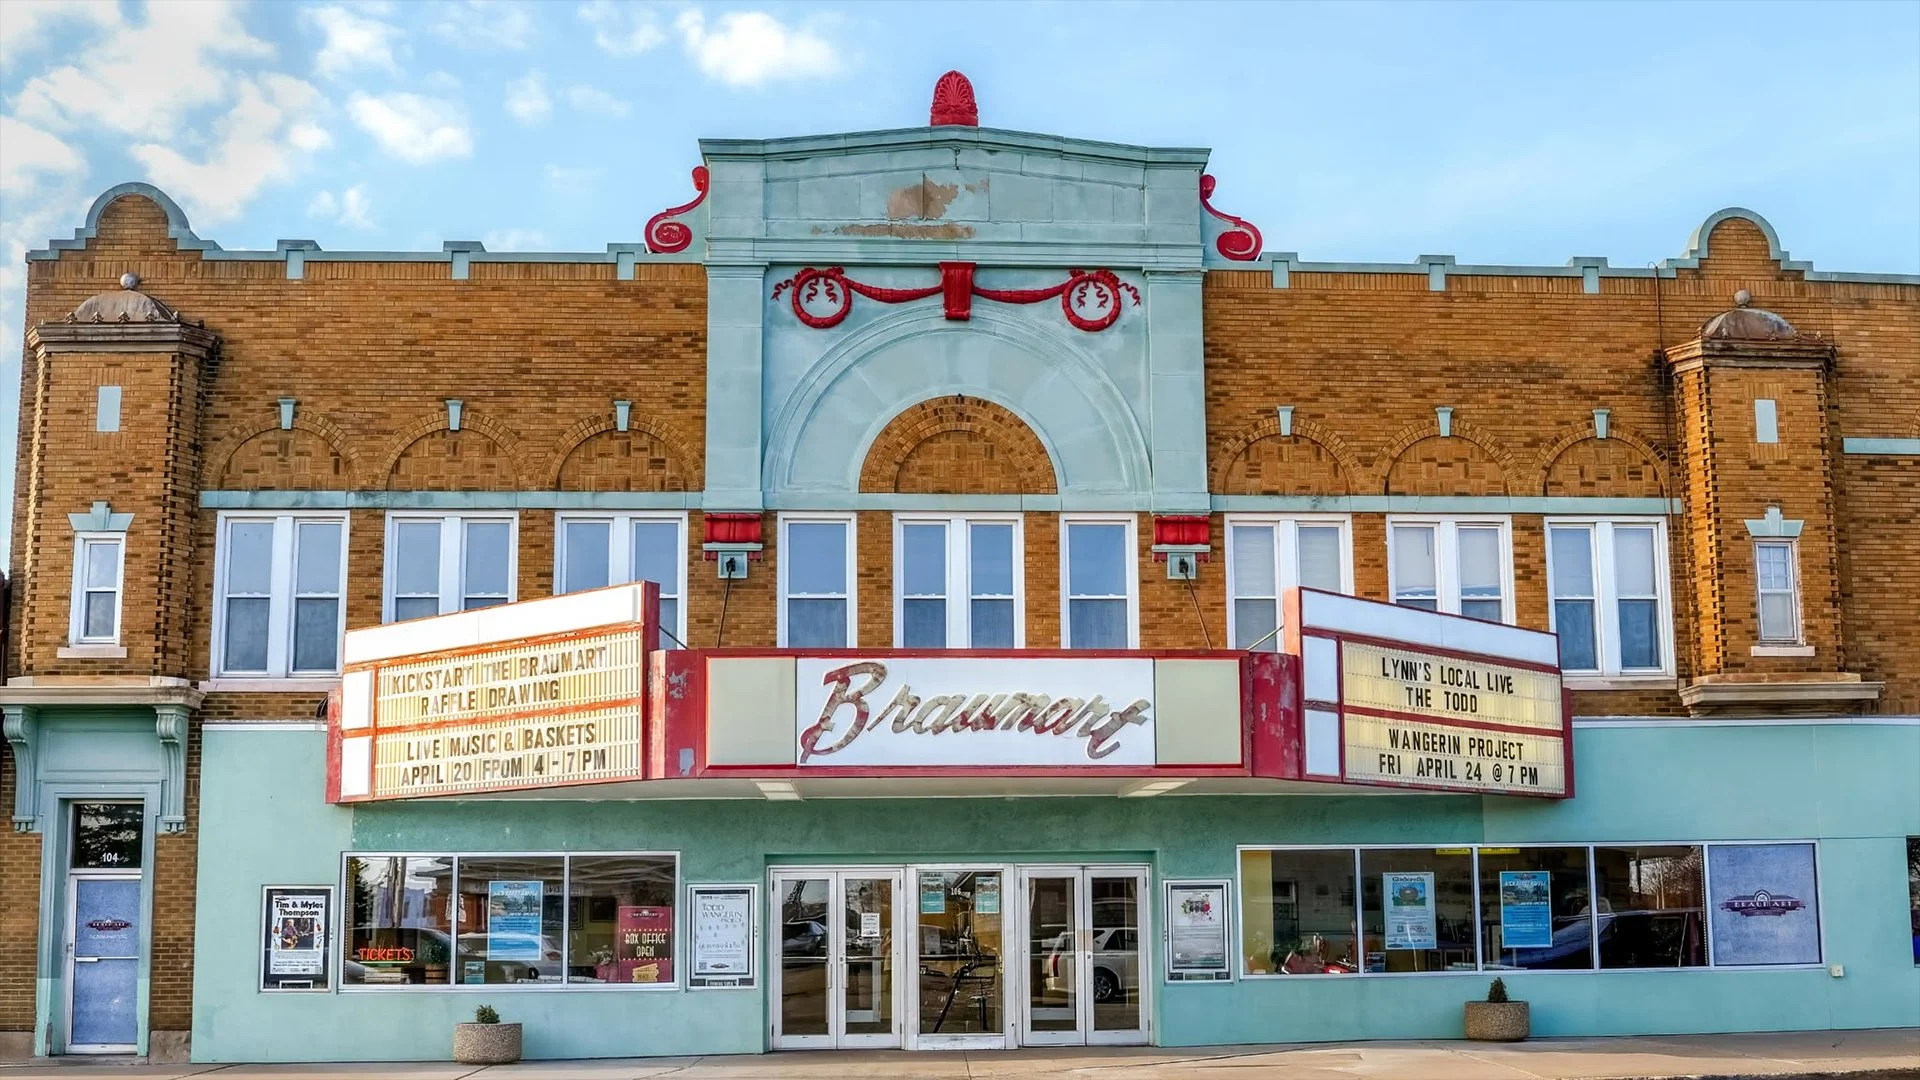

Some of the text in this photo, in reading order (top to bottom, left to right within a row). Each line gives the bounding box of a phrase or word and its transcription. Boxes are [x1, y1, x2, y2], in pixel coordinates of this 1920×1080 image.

[393, 646, 606, 694] KICKSTART THE BRAUMART
[1382, 657, 1513, 694] LYNN'S LOCAL LIVE
[421, 680, 559, 716] RAFFLE DRAWING
[1405, 686, 1477, 712] THE TODD
[799, 661, 1150, 763] Braumart
[407, 723, 595, 761] LIVE MUSIC & BASKETS
[1389, 729, 1524, 760] WANGERIN PROJECT
[401, 764, 444, 787] APRIL
[454, 762, 472, 782] 20
[1379, 753, 1538, 785] FRI APRIL 24 @ 7 PM
[102, 852, 118, 862] 104
[279, 908, 319, 917] Thompson
[291, 901, 299, 909] &
[300, 901, 324, 910] Myles
[625, 933, 666, 944] BOX OFFICE
[636, 946, 655, 957] OPEN
[359, 948, 411, 961] TICKETS
